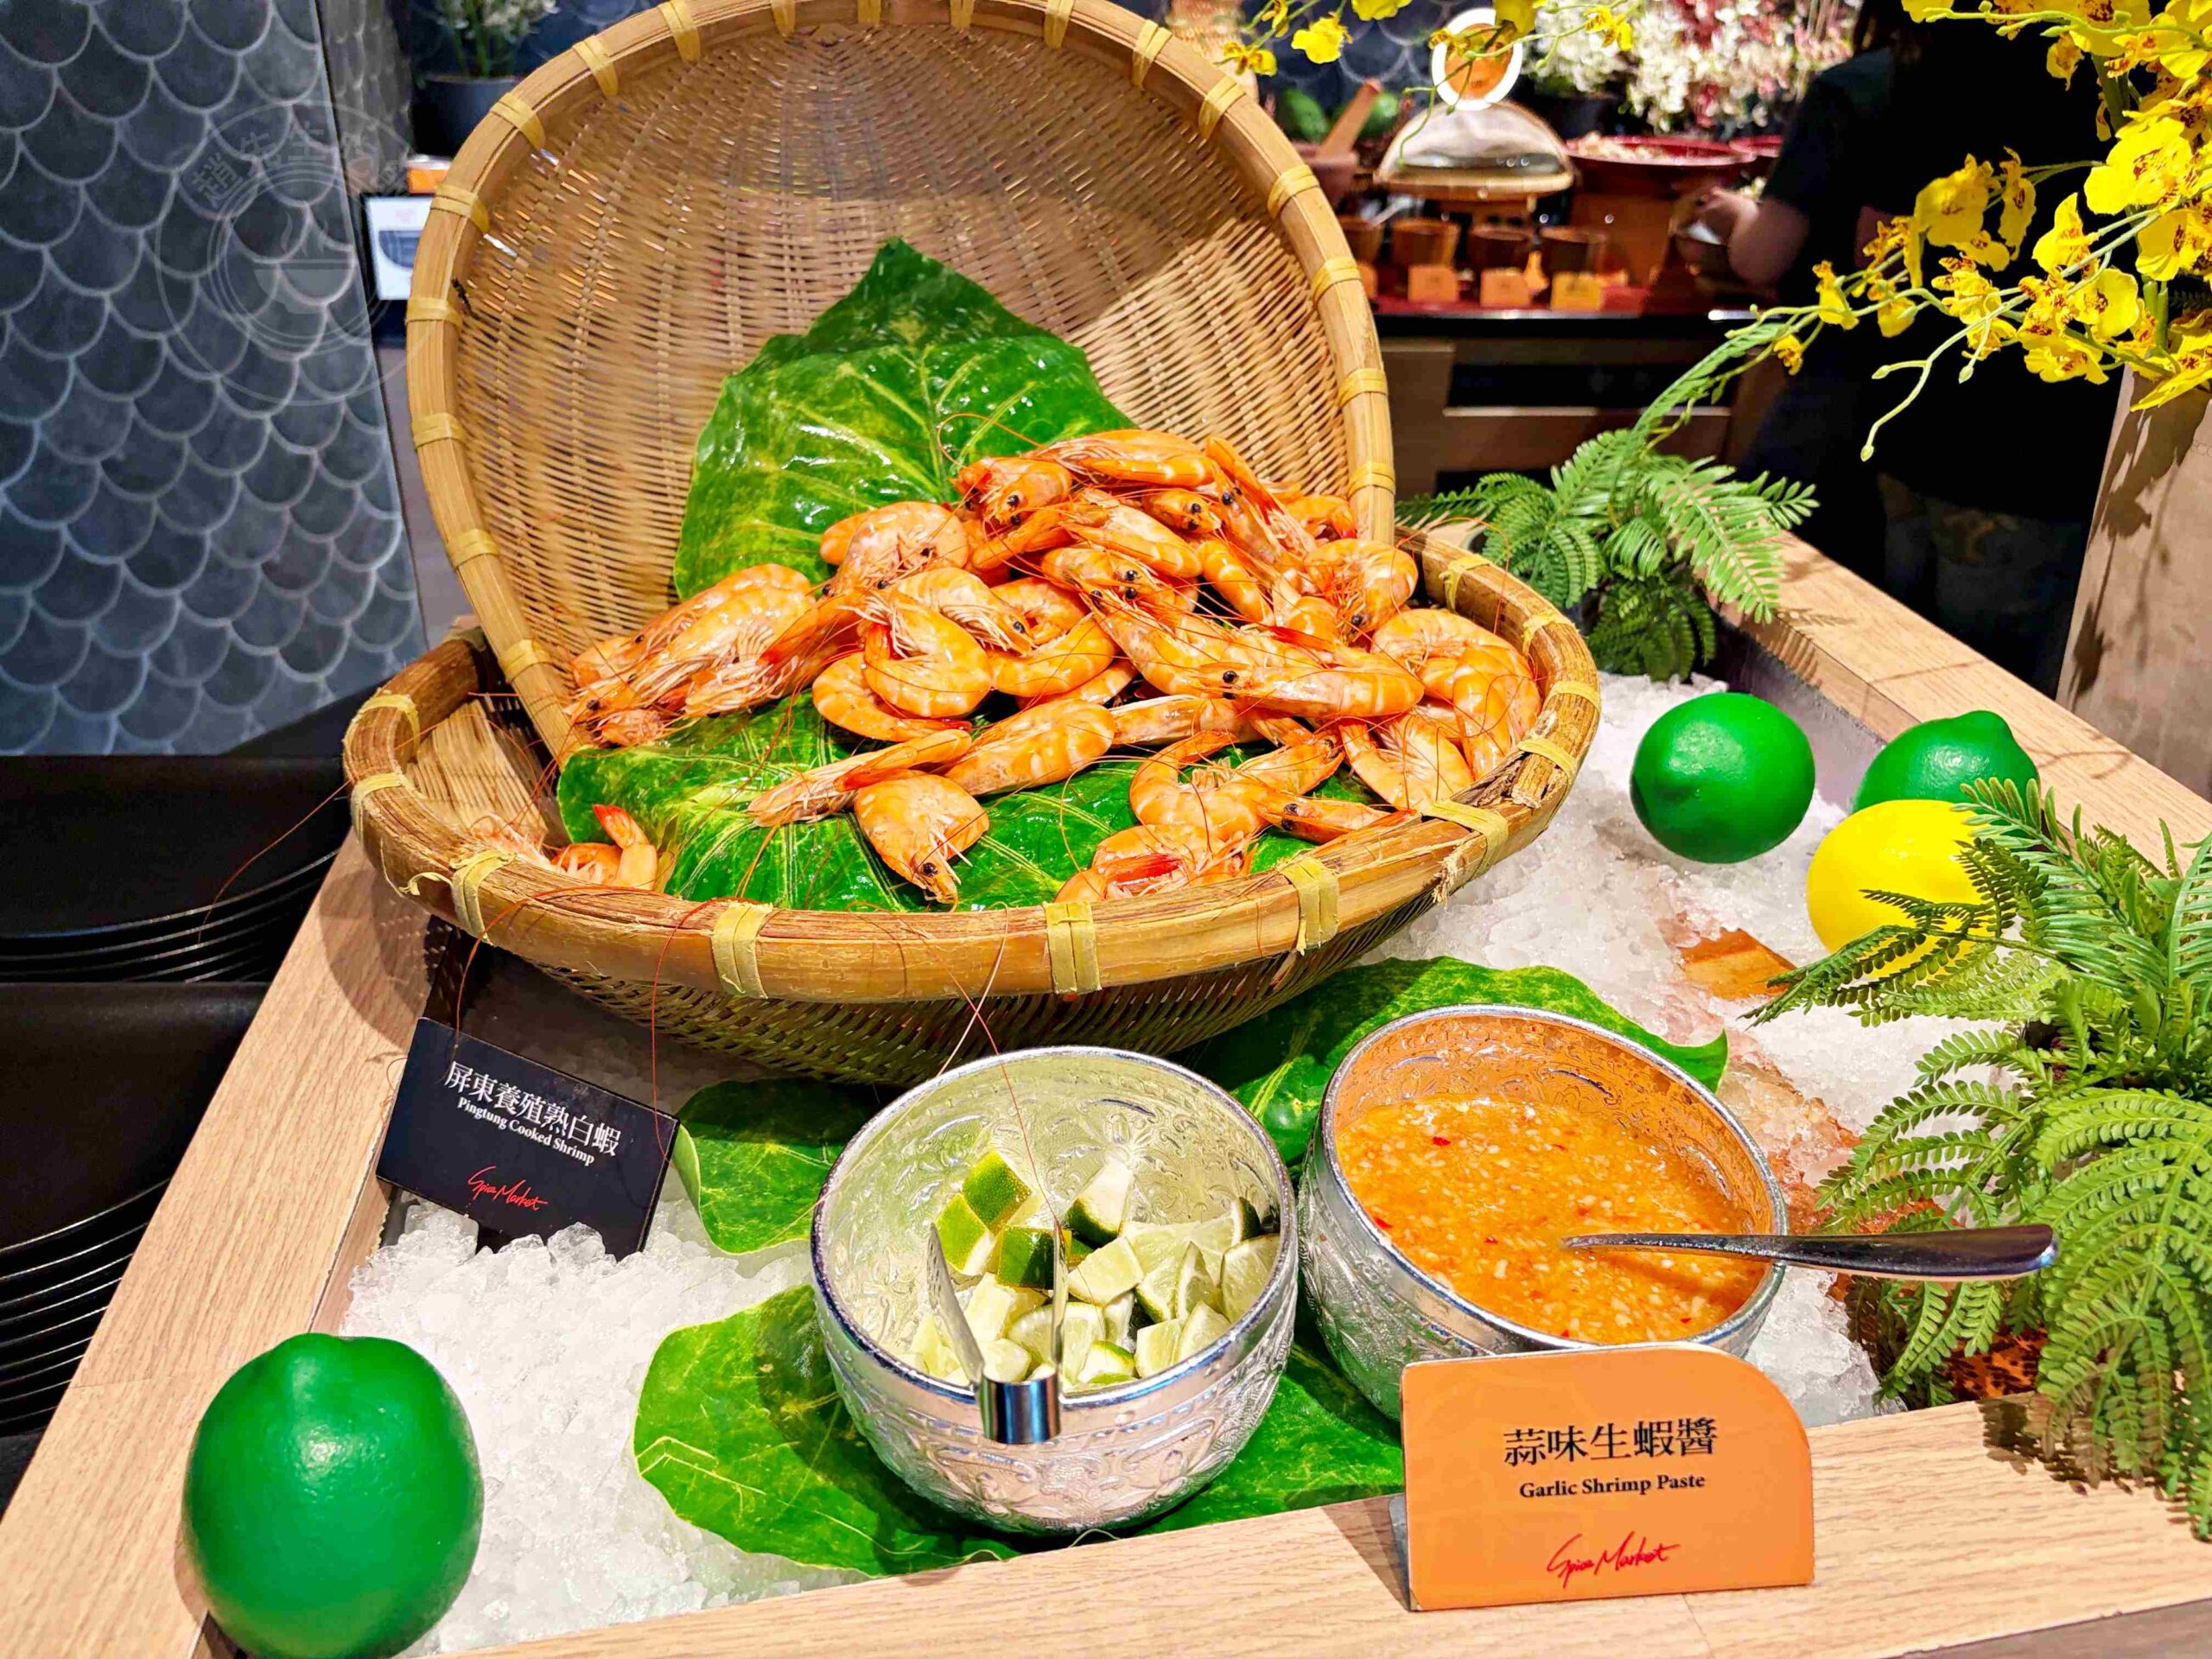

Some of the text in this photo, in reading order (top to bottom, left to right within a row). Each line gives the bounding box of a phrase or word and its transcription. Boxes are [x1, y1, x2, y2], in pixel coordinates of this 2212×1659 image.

[444, 1060, 622, 1157] 屏東養殖熟白蝦
[456, 1096, 595, 1166] Pingtung Cooked Shrimp
[467, 1165, 549, 1211] Spice Market
[1503, 1416, 1718, 1467] 蒜味生蝦醬
[1519, 1473, 1707, 1498] Garlic Shrimp Paste
[1546, 1529, 1681, 1590] Spice Market
